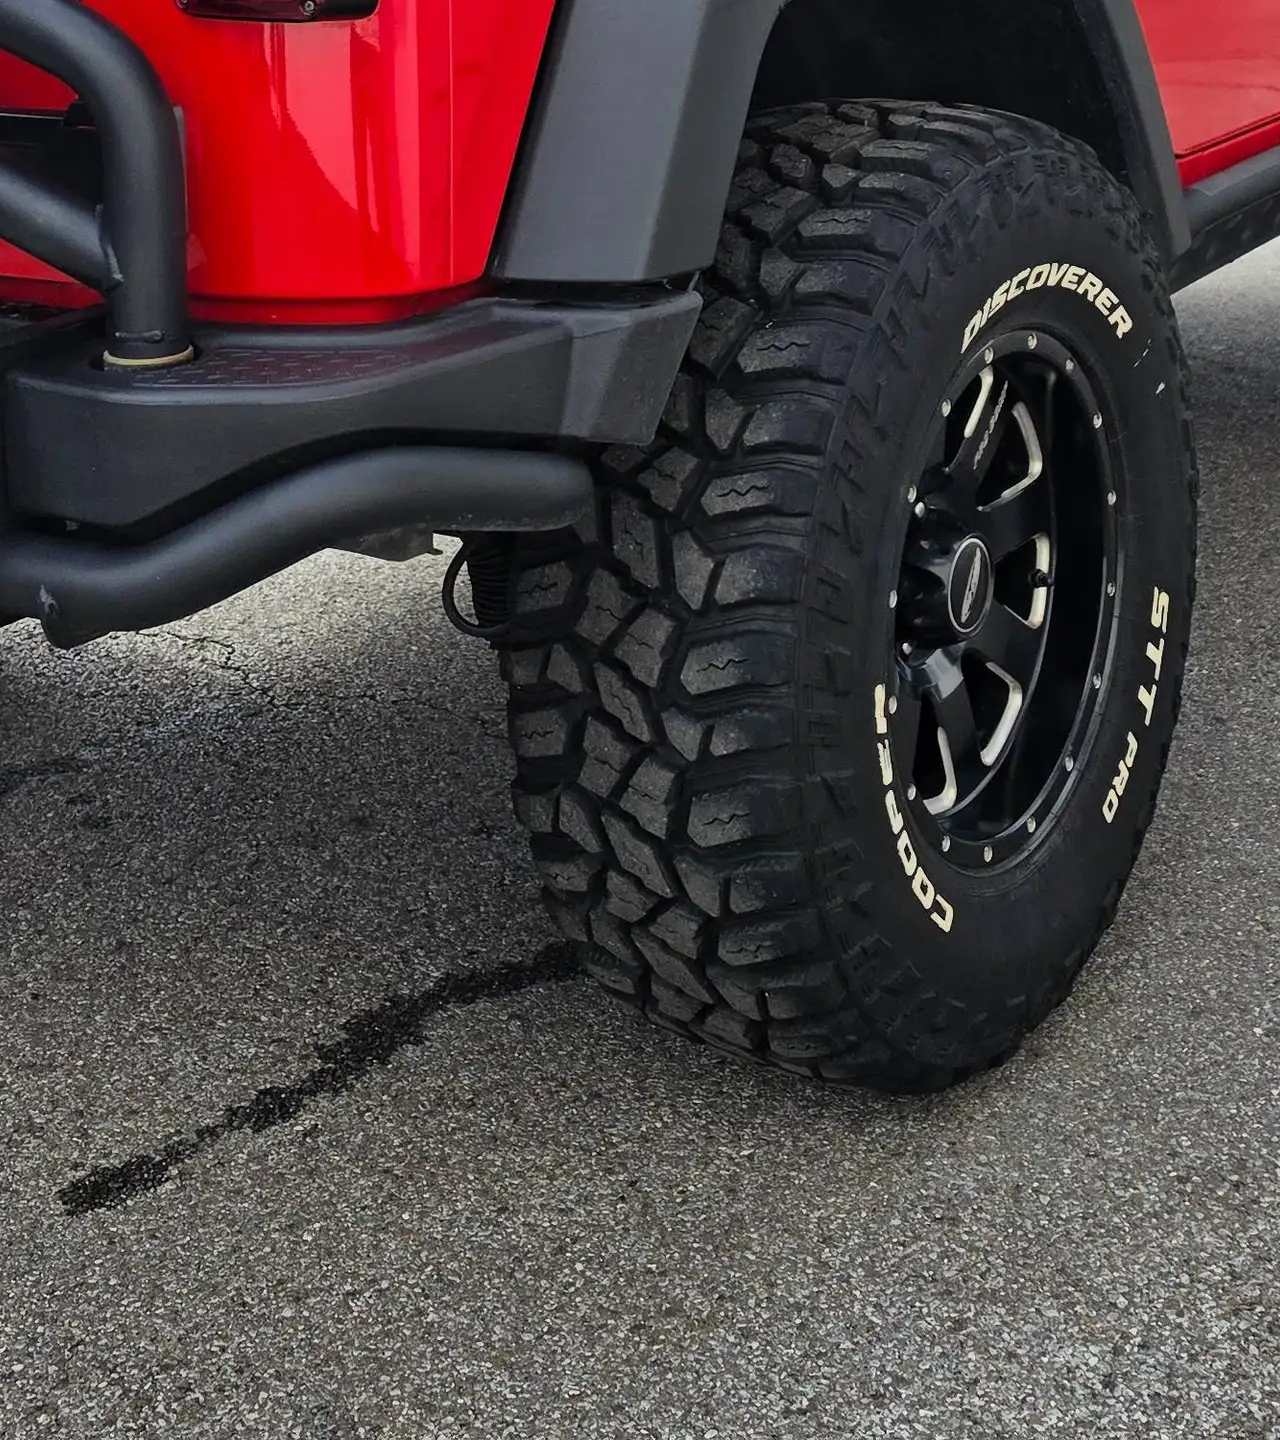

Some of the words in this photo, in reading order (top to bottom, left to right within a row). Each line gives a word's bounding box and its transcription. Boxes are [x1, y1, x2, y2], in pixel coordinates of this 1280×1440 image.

[961, 263, 1133, 353] DISCOVERER
[1137, 586, 1170, 727] STT
[1102, 731, 1138, 824] PRO
